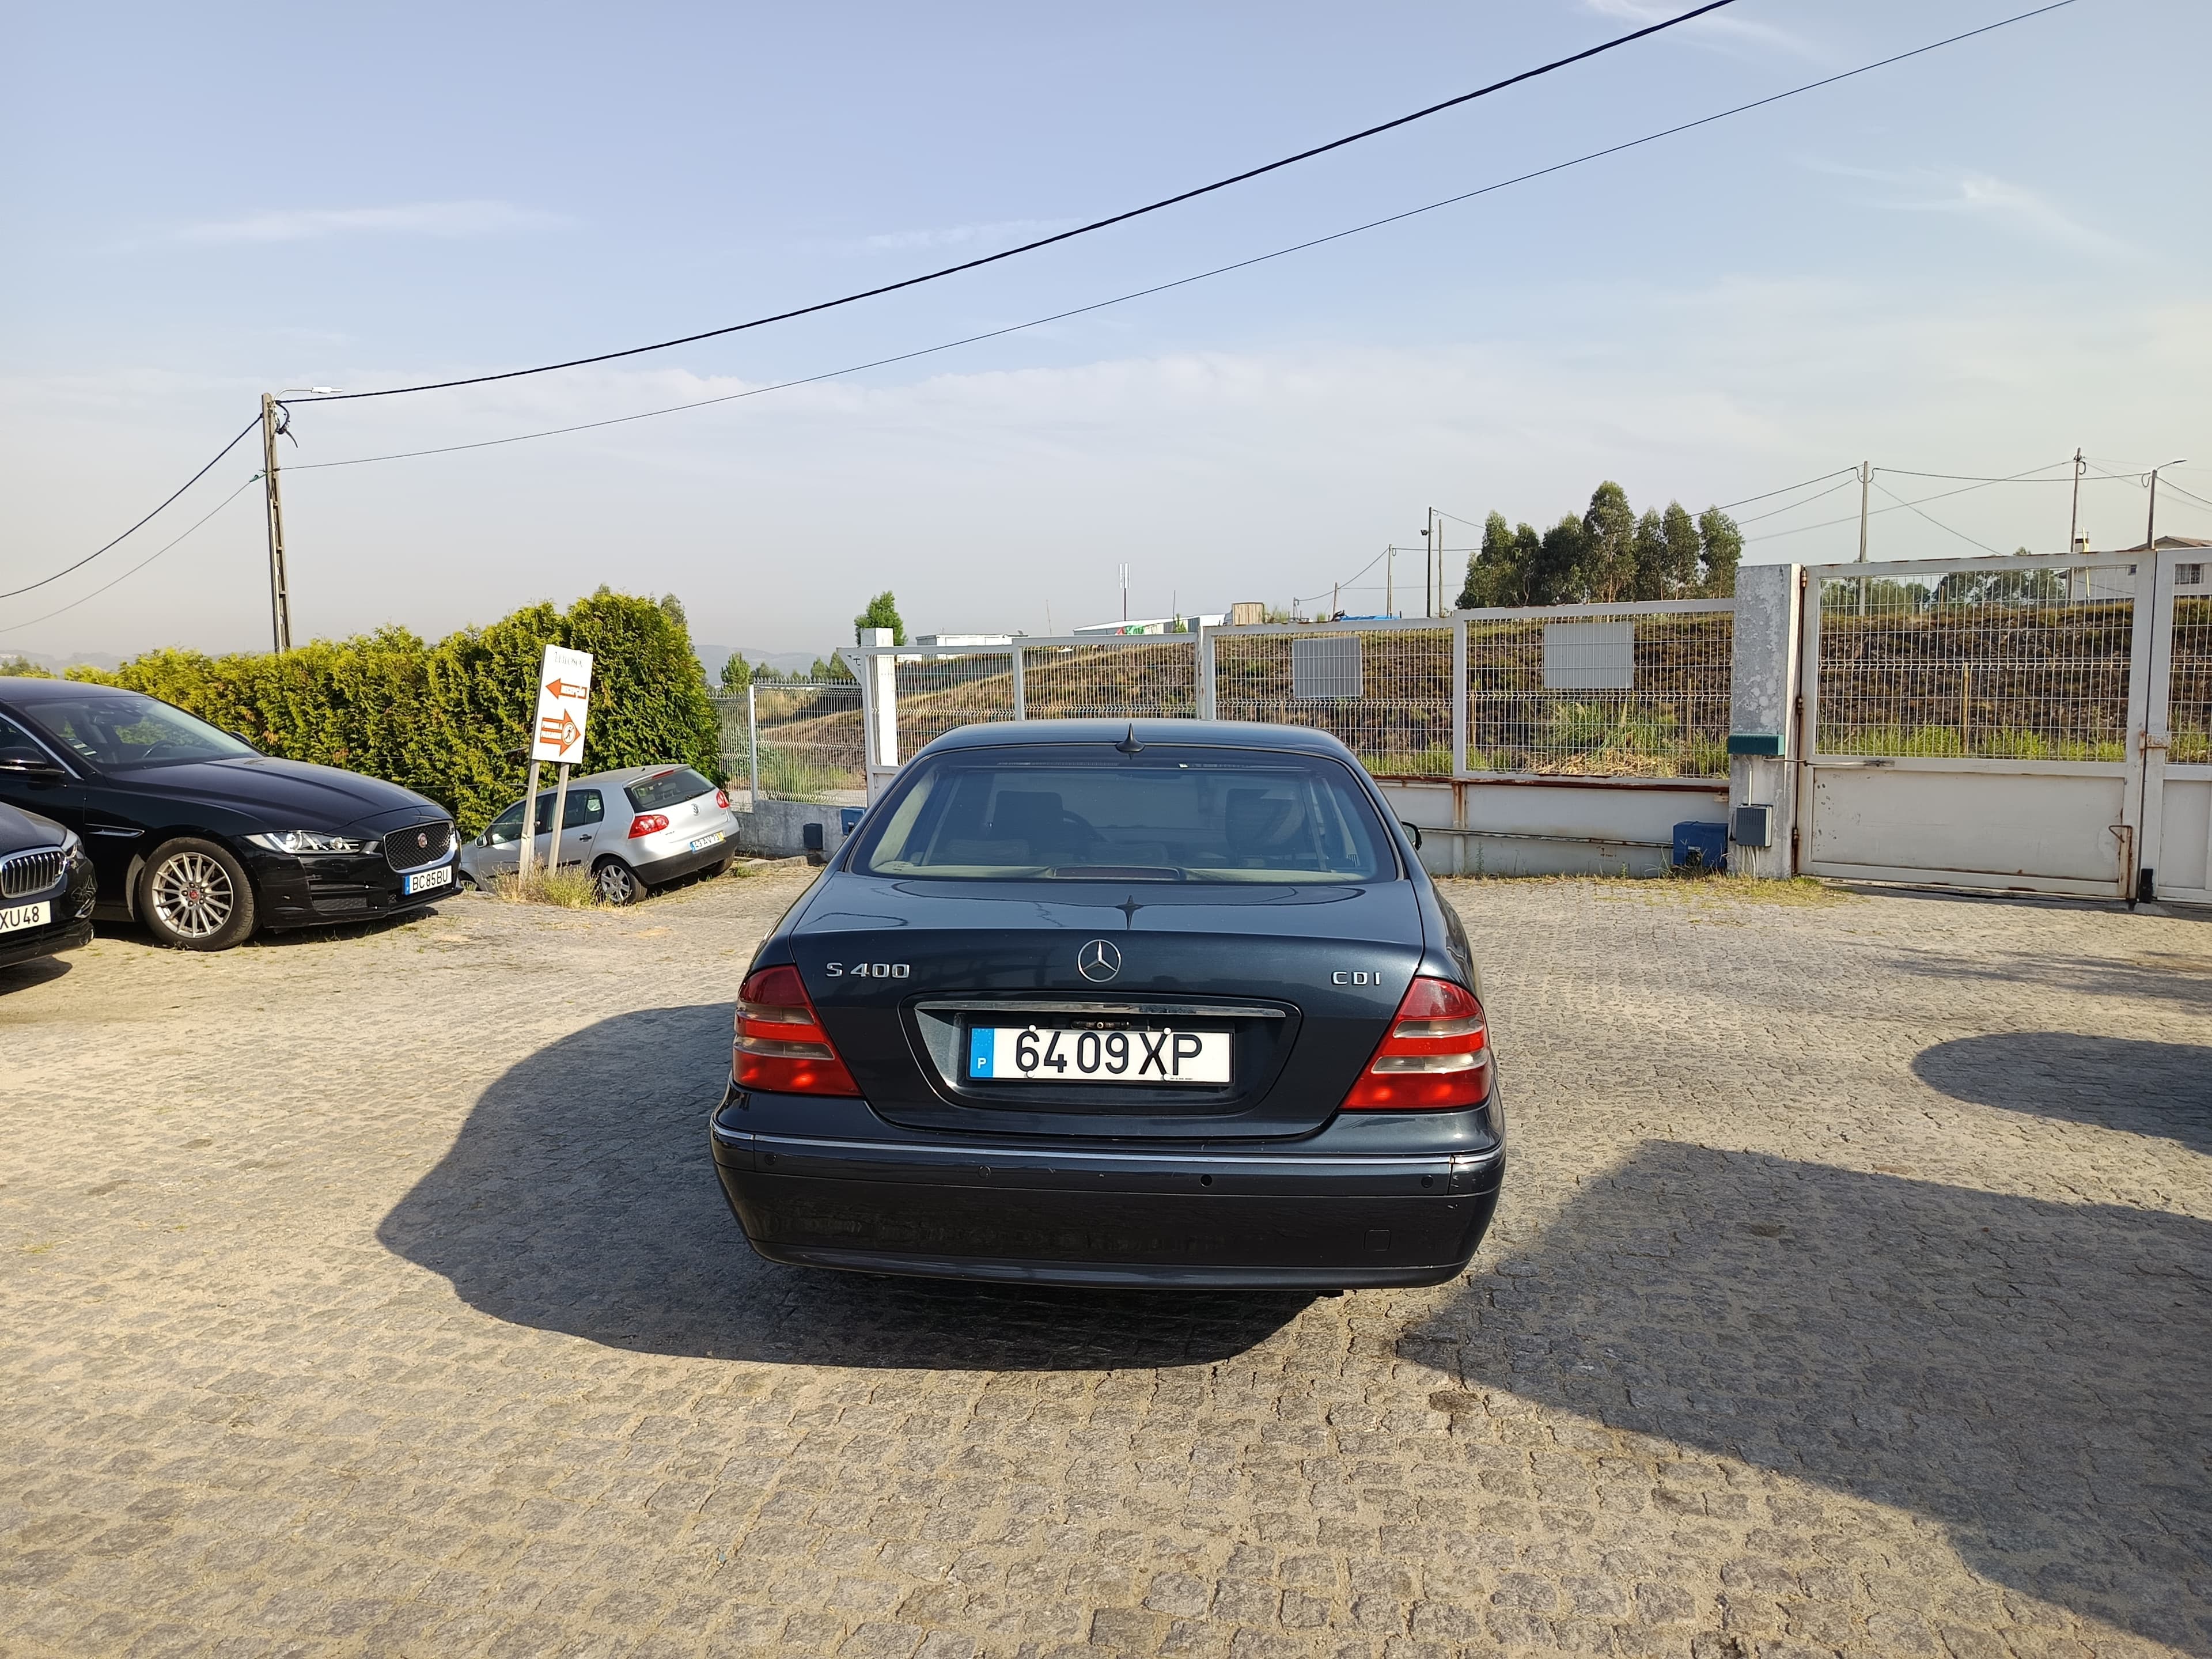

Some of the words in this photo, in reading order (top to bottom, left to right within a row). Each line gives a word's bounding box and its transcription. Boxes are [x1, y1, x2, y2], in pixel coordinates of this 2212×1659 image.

[826, 963, 843, 977] S
[850, 963, 910, 978] 400
[1332, 971, 1380, 986] CDI
[978, 1057, 986, 1069] P
